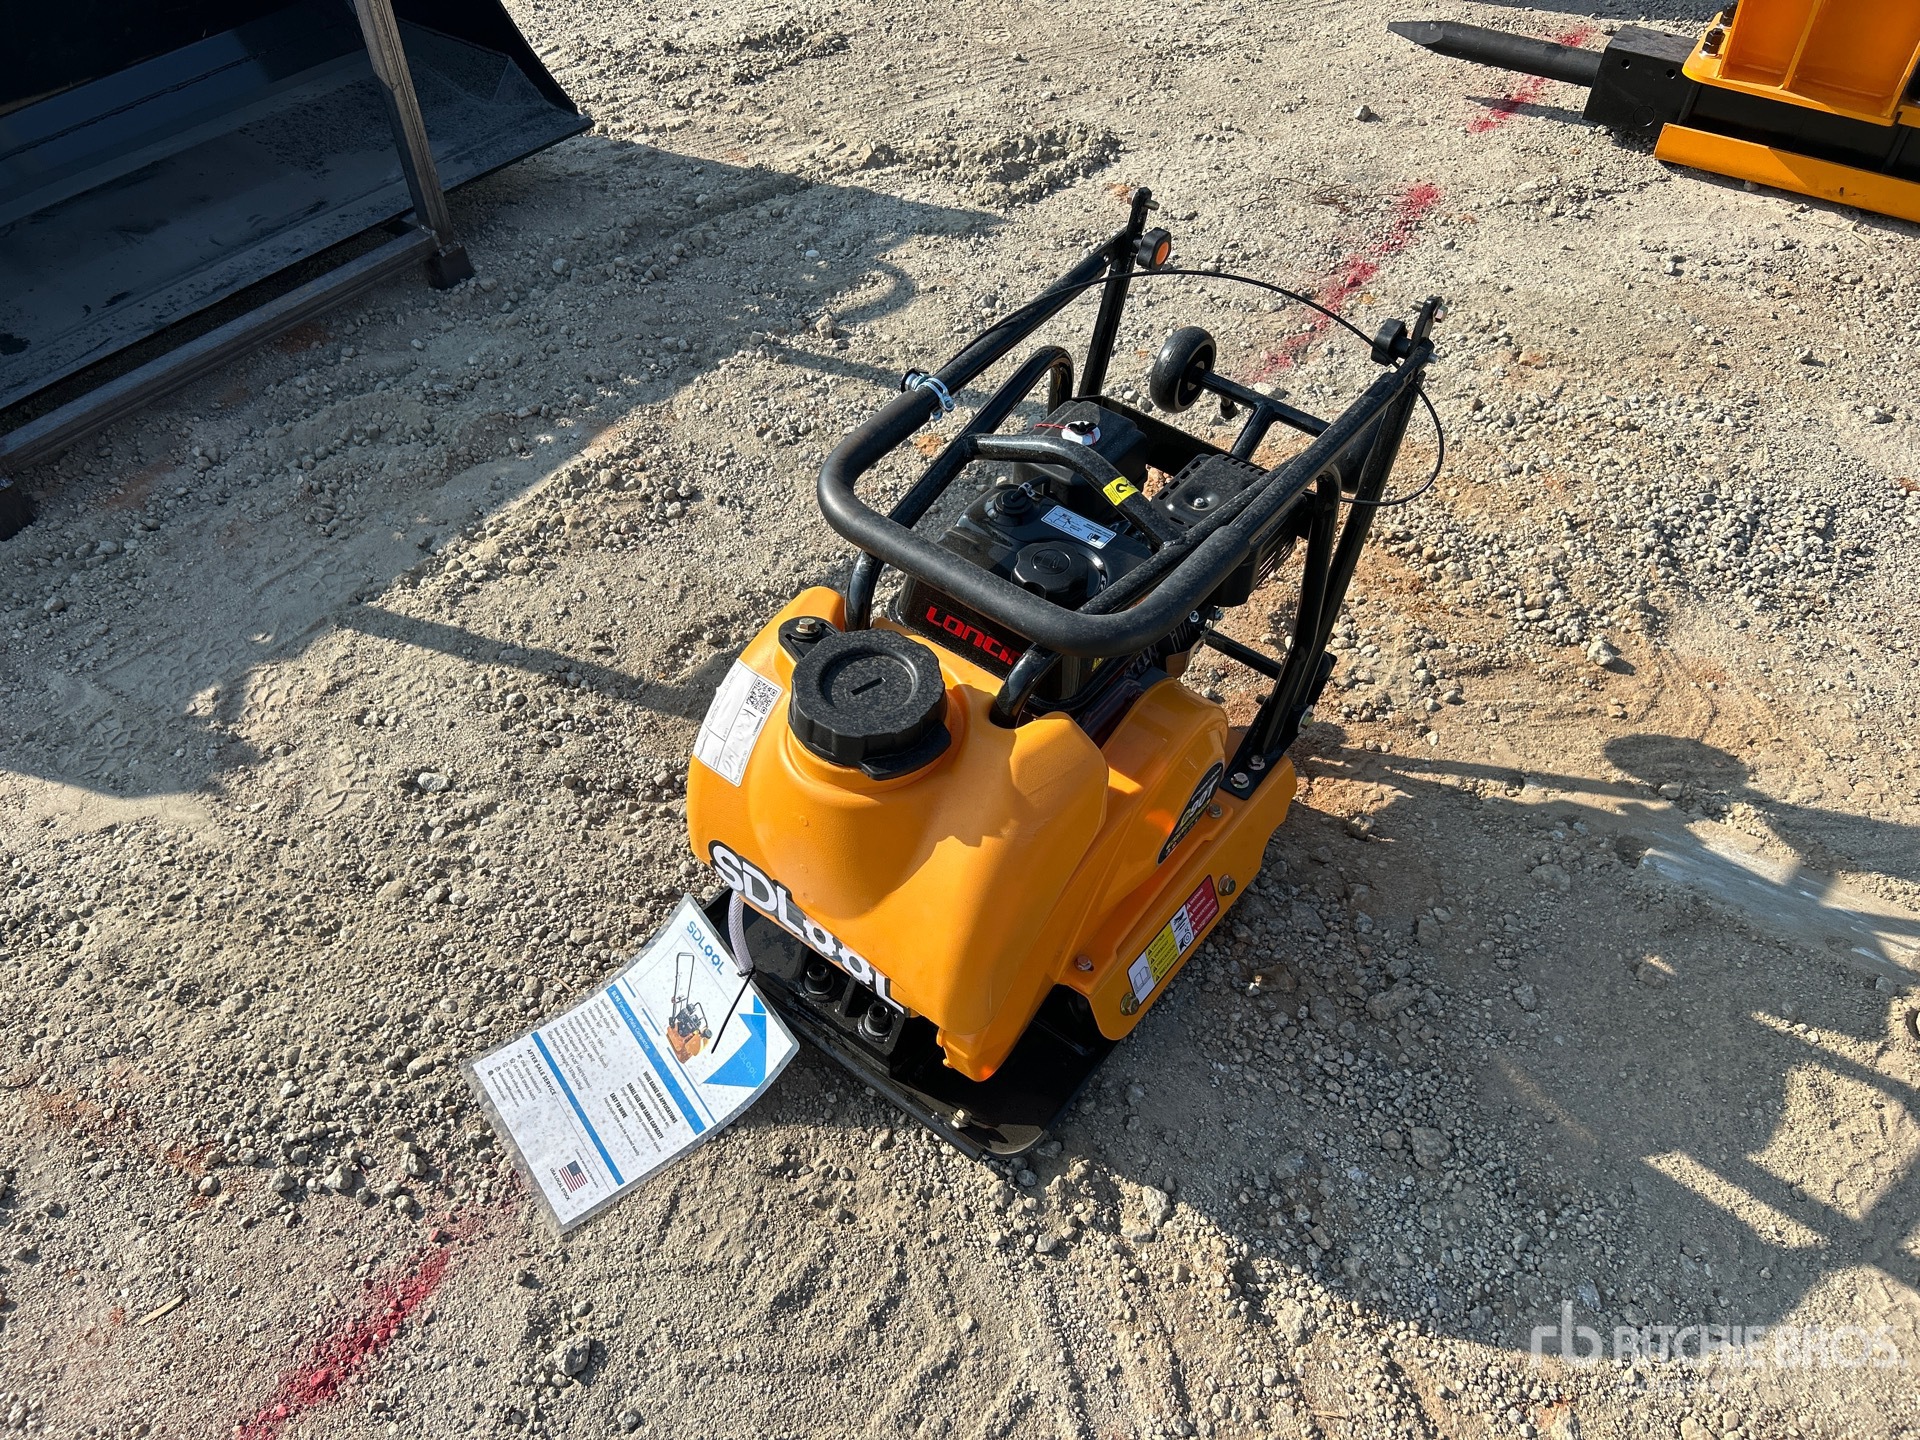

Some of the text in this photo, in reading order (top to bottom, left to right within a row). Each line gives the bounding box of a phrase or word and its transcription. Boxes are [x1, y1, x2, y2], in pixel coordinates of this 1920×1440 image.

[686, 920, 724, 976] SDLOOL
[526, 1047, 556, 1095] AFTER SALE SERVICE
